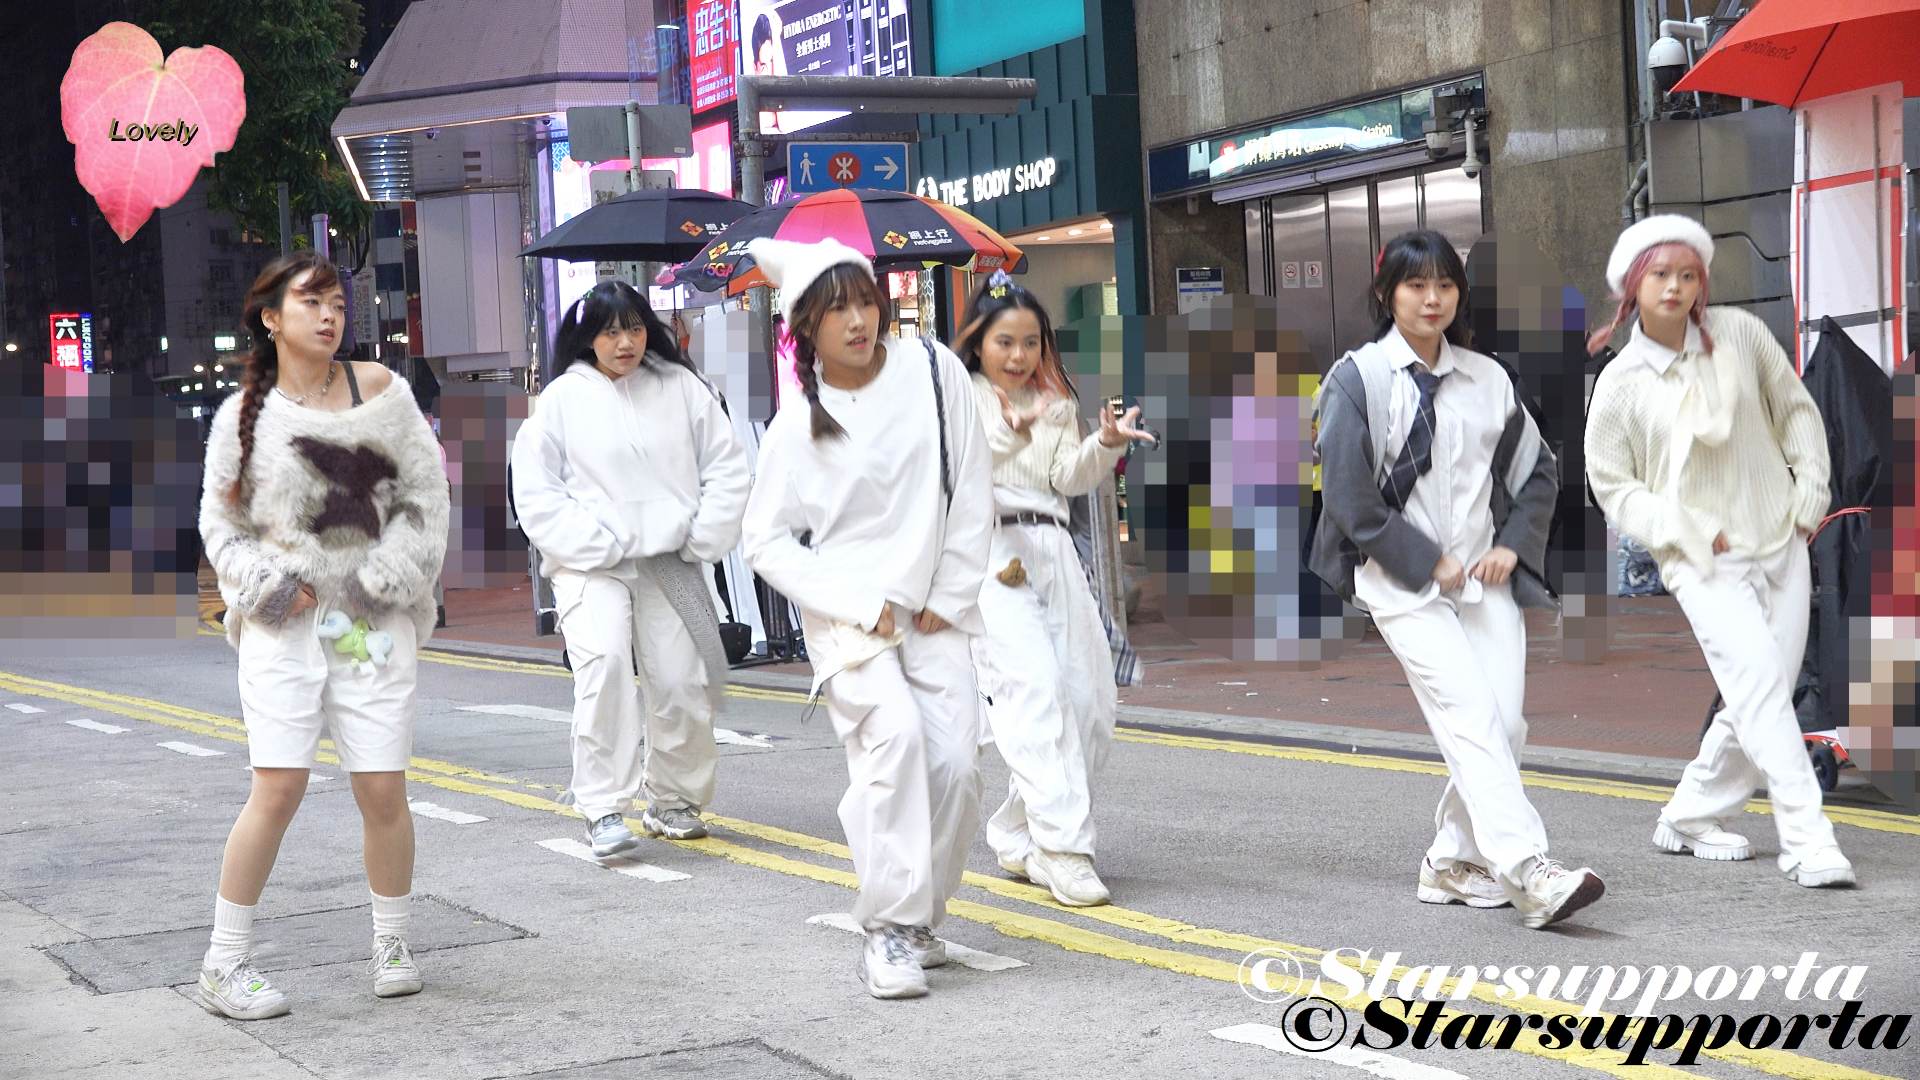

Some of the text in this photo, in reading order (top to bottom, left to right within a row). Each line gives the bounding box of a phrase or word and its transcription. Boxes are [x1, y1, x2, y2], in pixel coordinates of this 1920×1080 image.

[940, 157, 1056, 206] THE BODY SHOP
